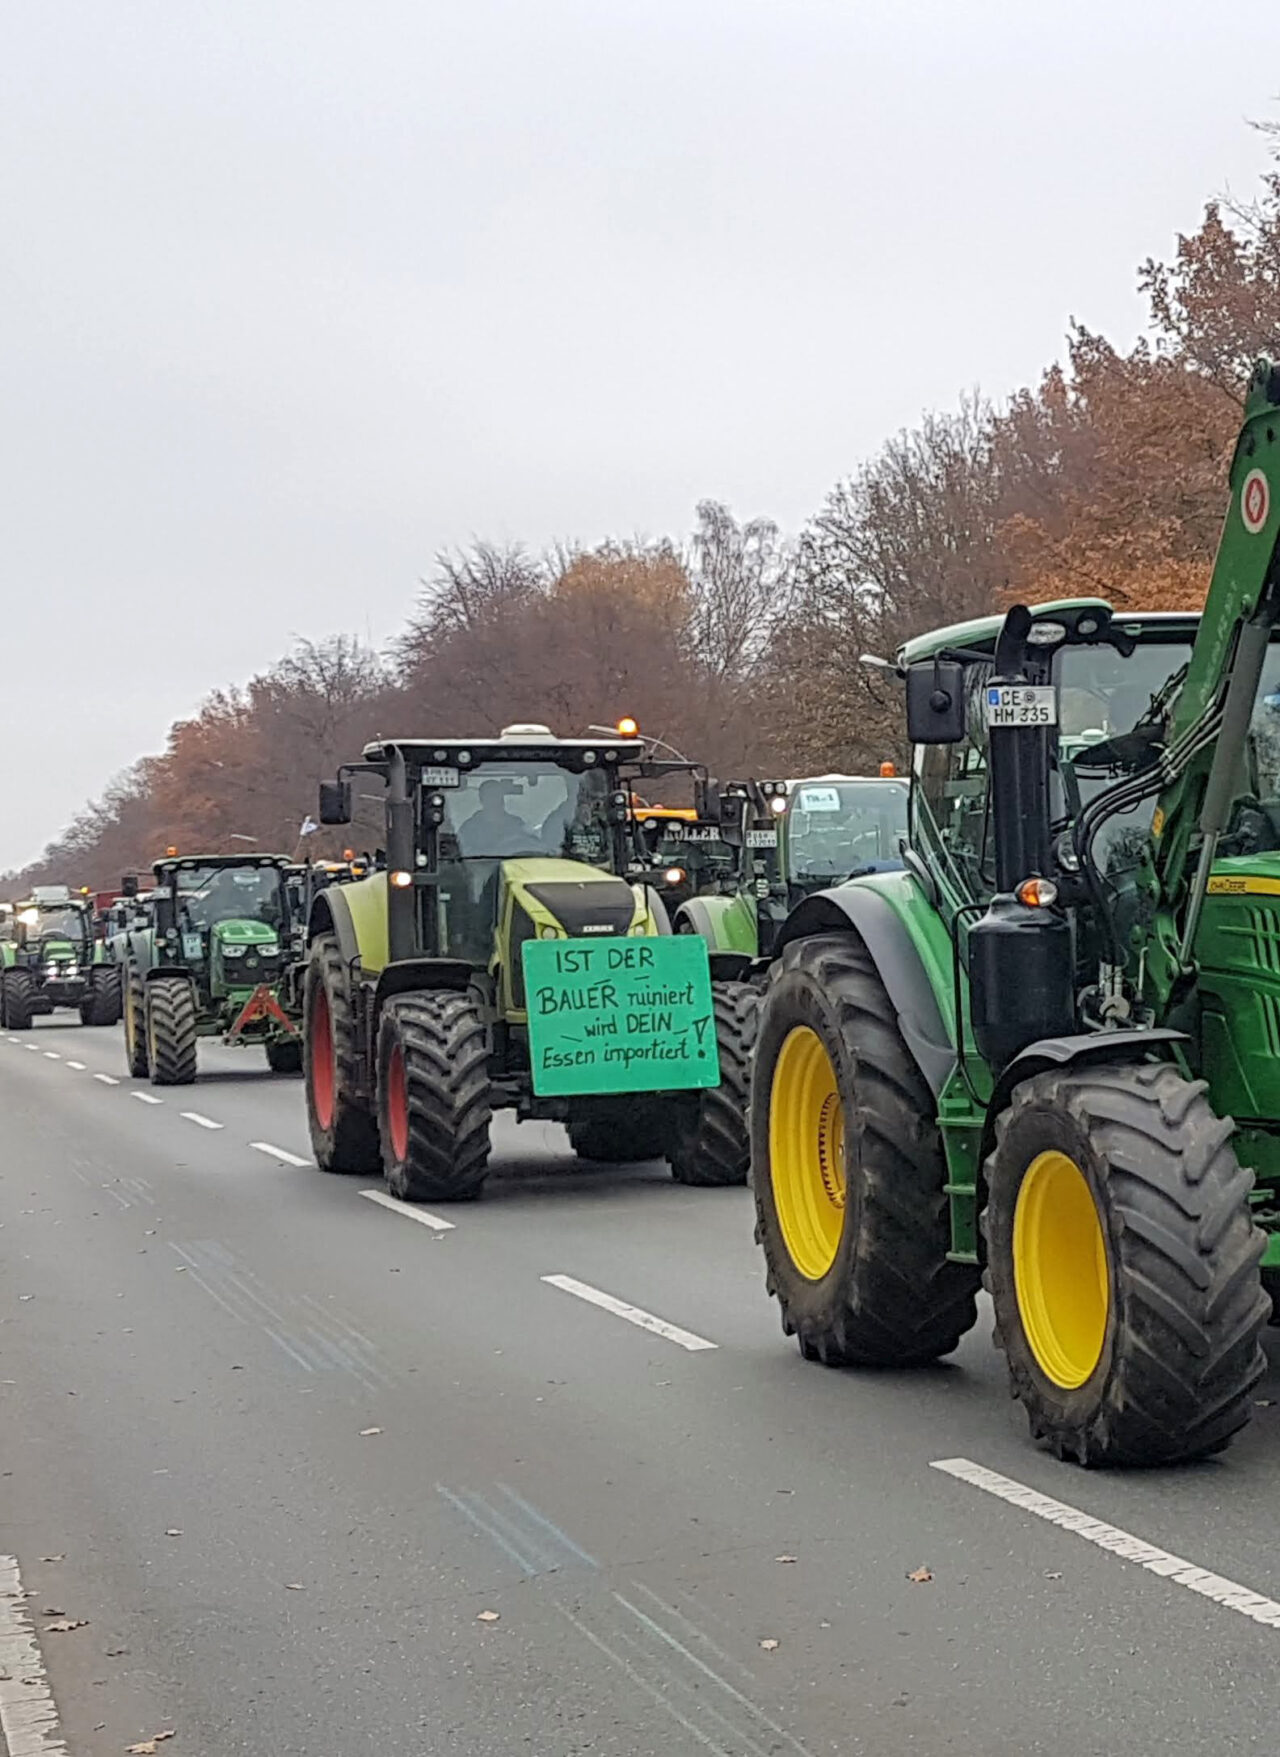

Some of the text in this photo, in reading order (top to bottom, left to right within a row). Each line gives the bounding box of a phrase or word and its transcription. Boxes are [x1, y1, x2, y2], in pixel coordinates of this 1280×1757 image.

[1002, 691, 1021, 705] CE
[995, 707, 1049, 722] HM 335
[555, 946, 655, 973] IST DER
[536, 981, 694, 1015] BAUER ruiniert
[584, 1012, 672, 1037] wird DEIN
[542, 1047, 595, 1069] Essen
[603, 1037, 690, 1070] importiert
